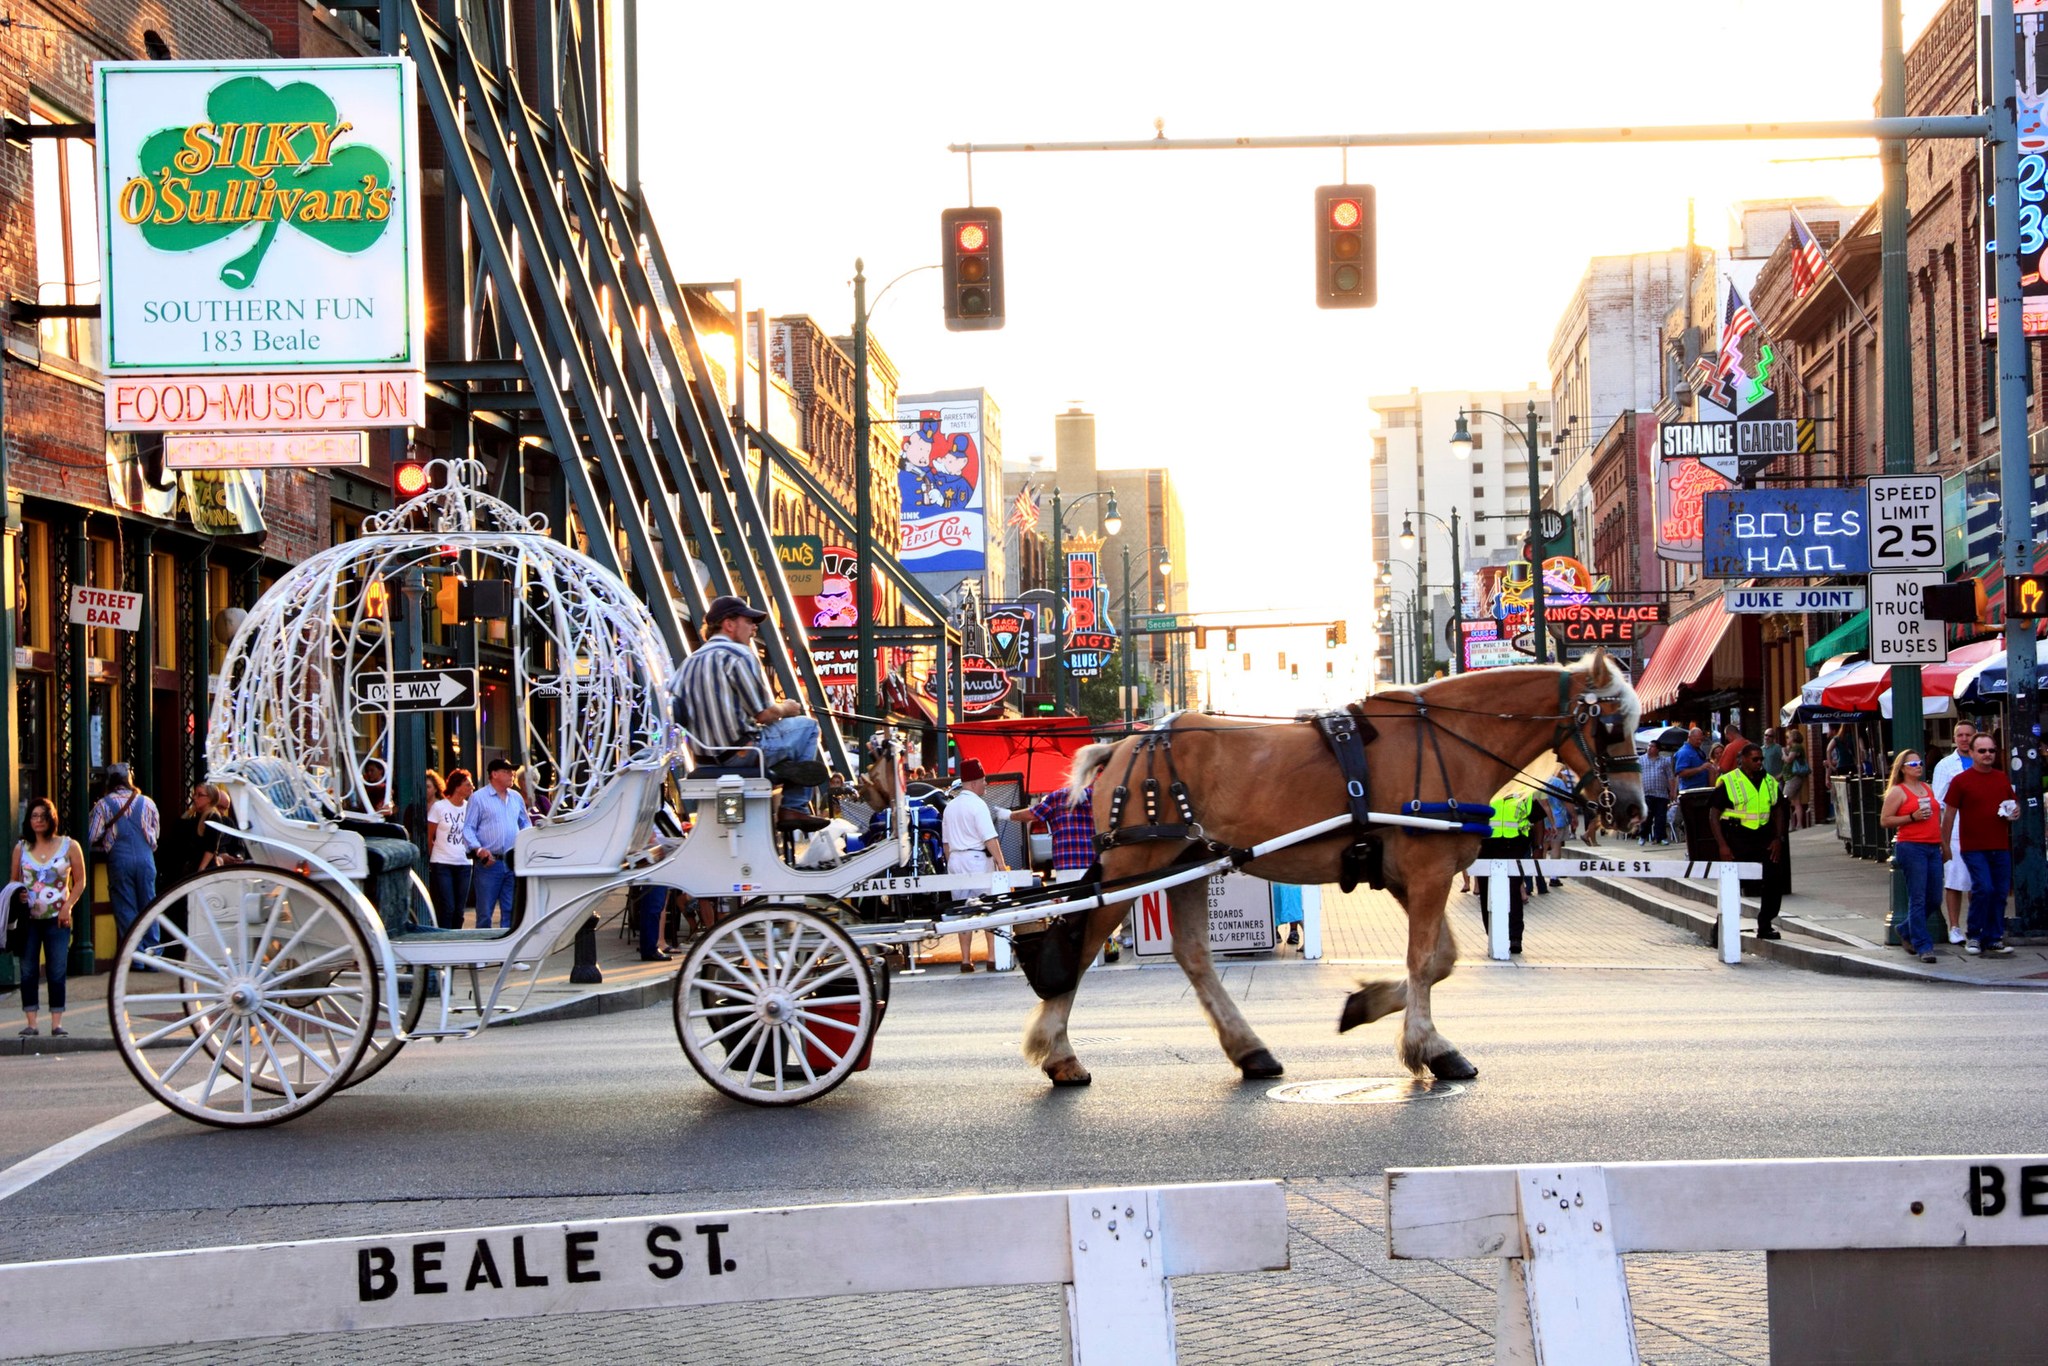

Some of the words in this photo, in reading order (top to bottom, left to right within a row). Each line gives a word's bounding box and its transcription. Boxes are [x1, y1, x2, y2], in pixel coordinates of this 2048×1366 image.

[174, 121, 353, 175] SILKY
[119, 167, 394, 224] O'Sullivan's
[143, 299, 304, 324] SOUTHERN
[315, 297, 374, 320] FUN
[201, 330, 243, 352] 183
[253, 329, 321, 351] Beale
[943, 412, 977, 420] ARRESTING
[1664, 423, 1734, 456] STRANGE
[1740, 421, 1794, 453] CARGO
[169, 438, 271, 464] KITCHEN
[284, 436, 357, 461] OPEN
[1875, 486, 1937, 501] SPEED
[900, 512, 920, 520] RINK
[1881, 506, 1930, 520] LIMIT
[1541, 512, 1562, 538] LUB
[1665, 519, 1703, 539] ROO
[1735, 510, 1861, 538] BLUES
[1877, 524, 1937, 558] 25
[1747, 545, 1847, 572] HALL
[1070, 560, 1094, 591] B
[1896, 582, 1919, 597] NO
[78, 590, 136, 610] STREET
[1734, 592, 1784, 608] JUKE
[1795, 591, 1854, 607] JOINT
[1071, 596, 1095, 629] B
[1593, 607, 1659, 621] PALACE
[1876, 601, 1925, 615] TRUCK
[86, 608, 121, 626] BAR
[1147, 620, 1176, 630] Second
[1566, 623, 1633, 640] CAFE
[1897, 620, 1920, 635] OR
[1881, 639, 1938, 654] BUSES
[1071, 653, 1098, 669] BLUES
[1071, 668, 1098, 677] CLUB
[408, 682, 441, 698] WAY
[1579, 860, 1626, 873] BEALE
[1633, 860, 1652, 873] ST.
[852, 878, 897, 892] BEALE
[904, 877, 921, 889] ST.
[1209, 909, 1244, 919] EBOARDS
[1218, 920, 1265, 930] CONTAINERS
[1209, 931, 1266, 943] ALS/REPTILES
[358, 1230, 601, 1302] BEALE
[646, 1223, 738, 1280] ST.
